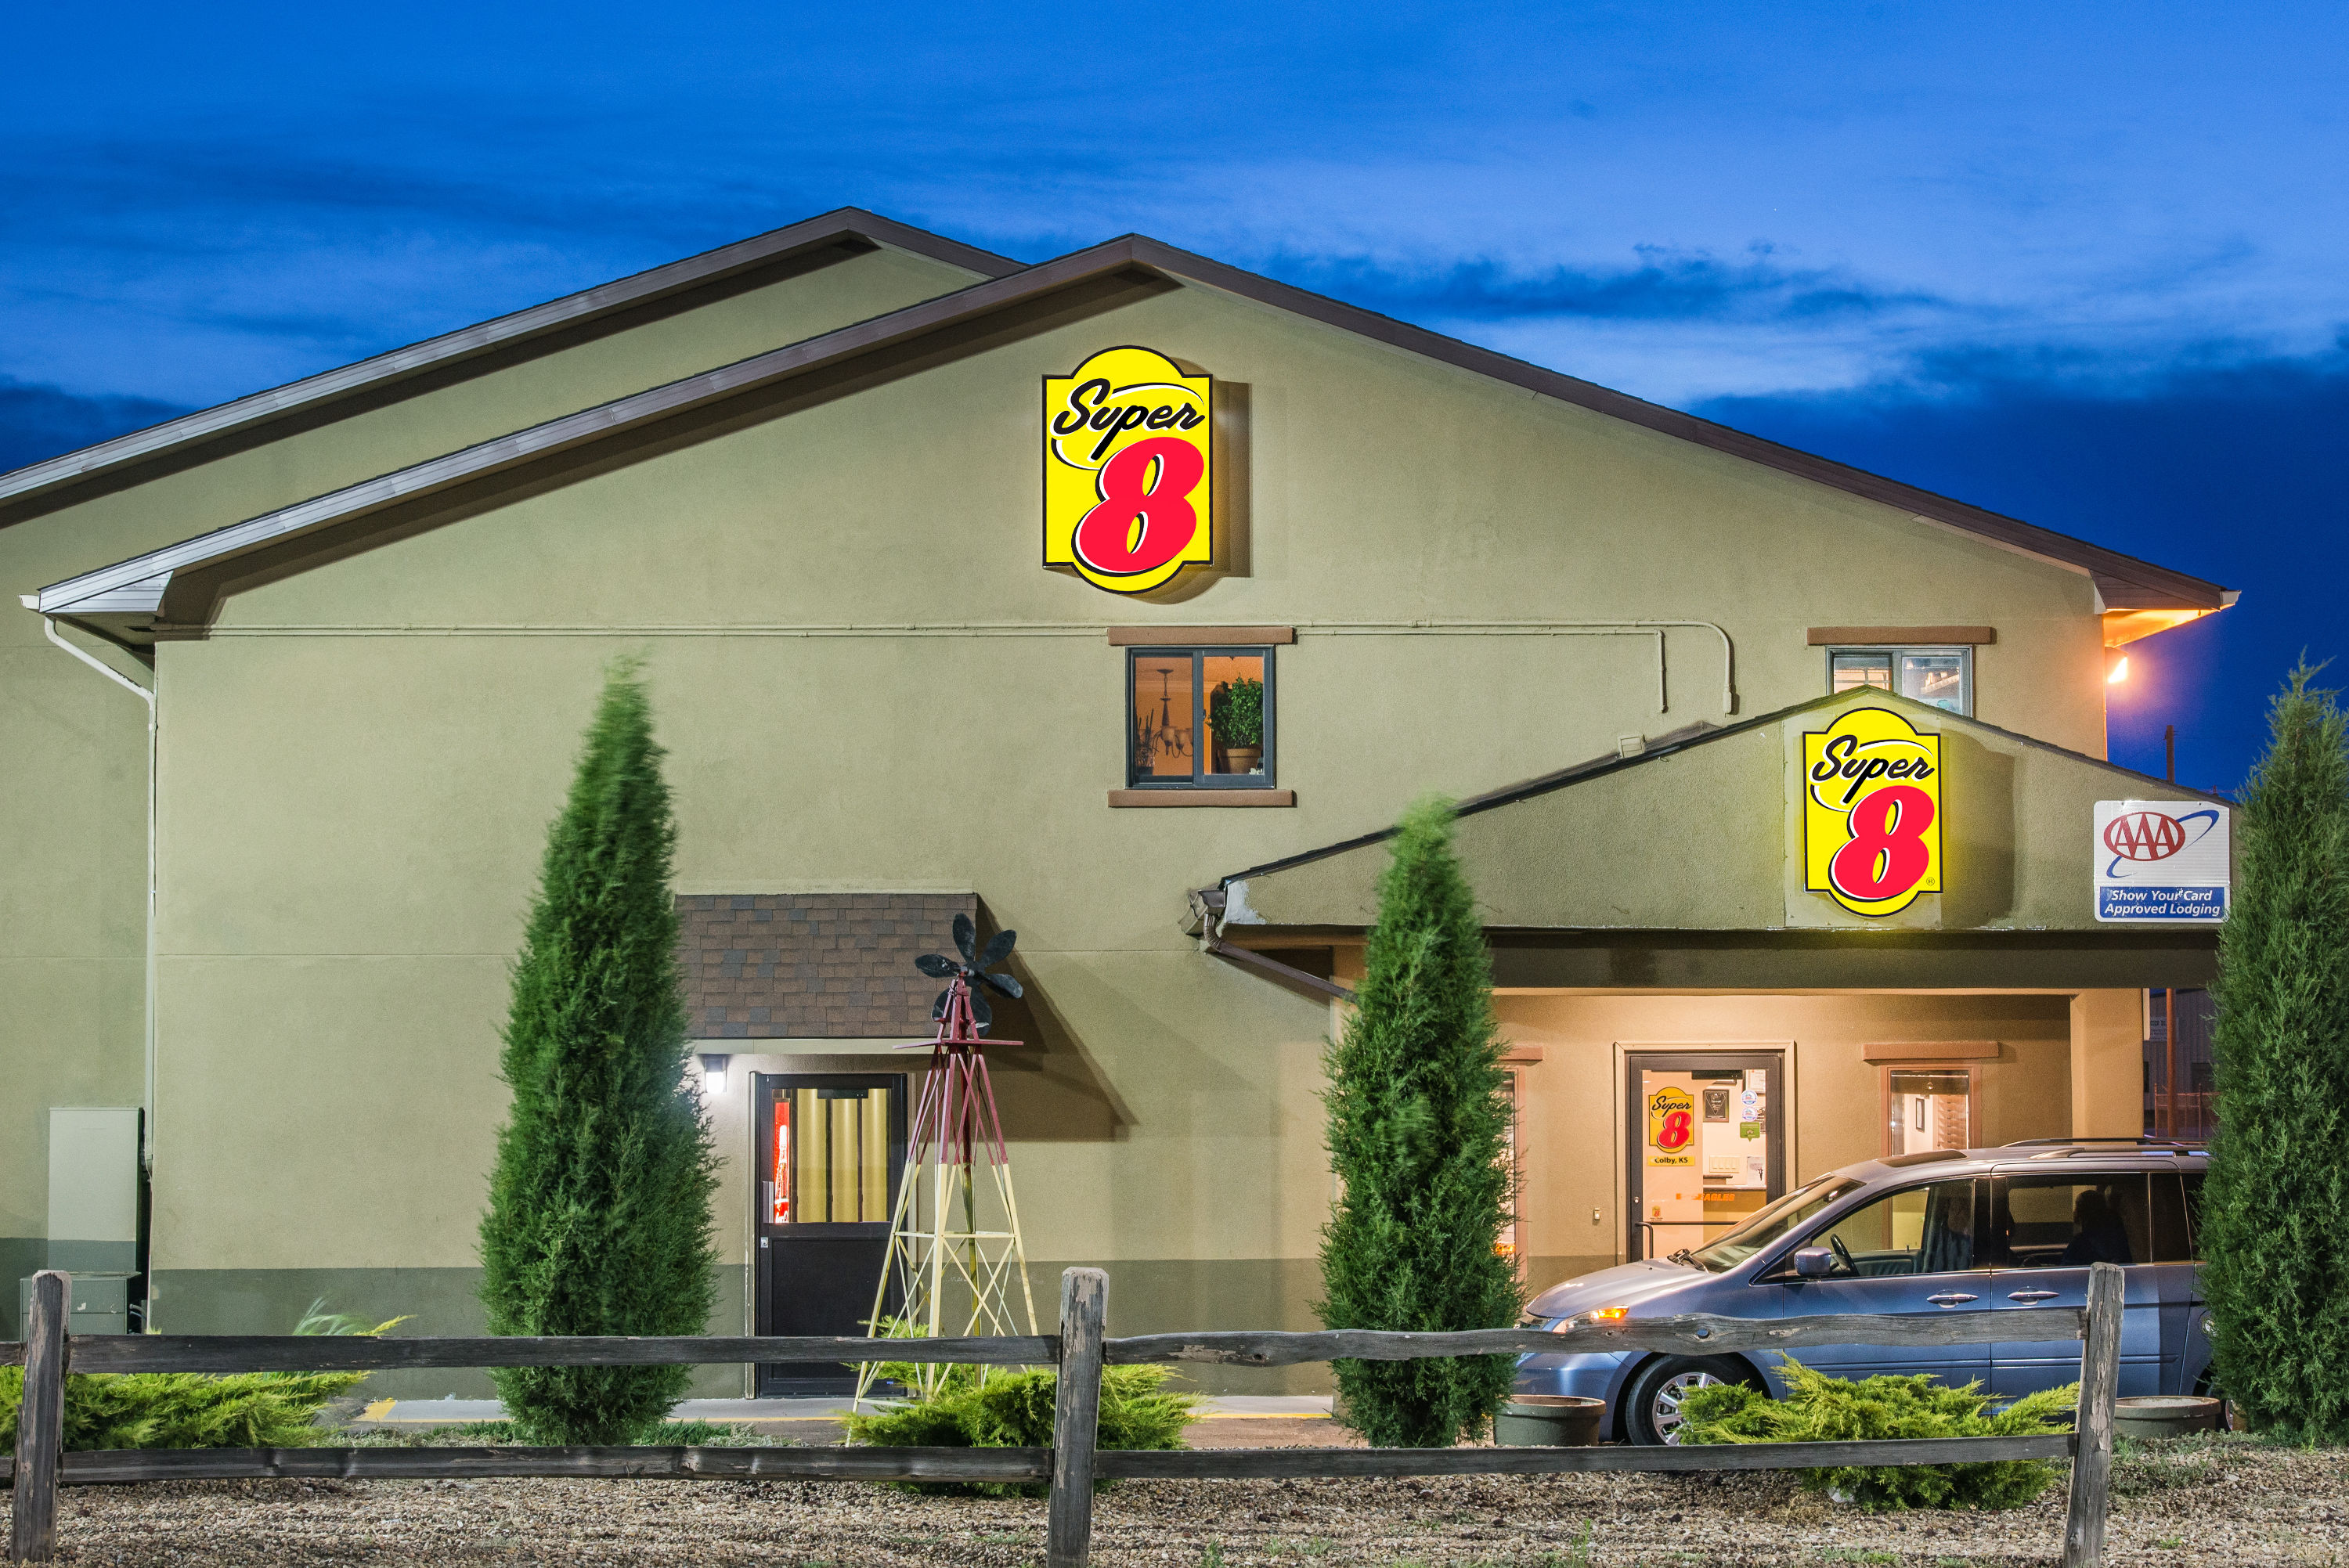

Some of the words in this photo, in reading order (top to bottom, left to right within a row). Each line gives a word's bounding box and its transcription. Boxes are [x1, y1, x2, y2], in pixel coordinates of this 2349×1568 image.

[1050, 377, 1206, 462] Super
[1071, 436, 1204, 577] 8
[1810, 734, 1936, 806] Super
[1828, 785, 1935, 903] 8
[2105, 812, 2185, 861] AAA
[2104, 903, 2167, 917] Approved
[2170, 903, 2221, 917] Lodging
[2111, 890, 2147, 901] Show
[2151, 890, 2179, 901] Your
[2183, 890, 2213, 901] Card
[1651, 1095, 1691, 1117] Super
[1657, 1112, 1691, 1148] 8
